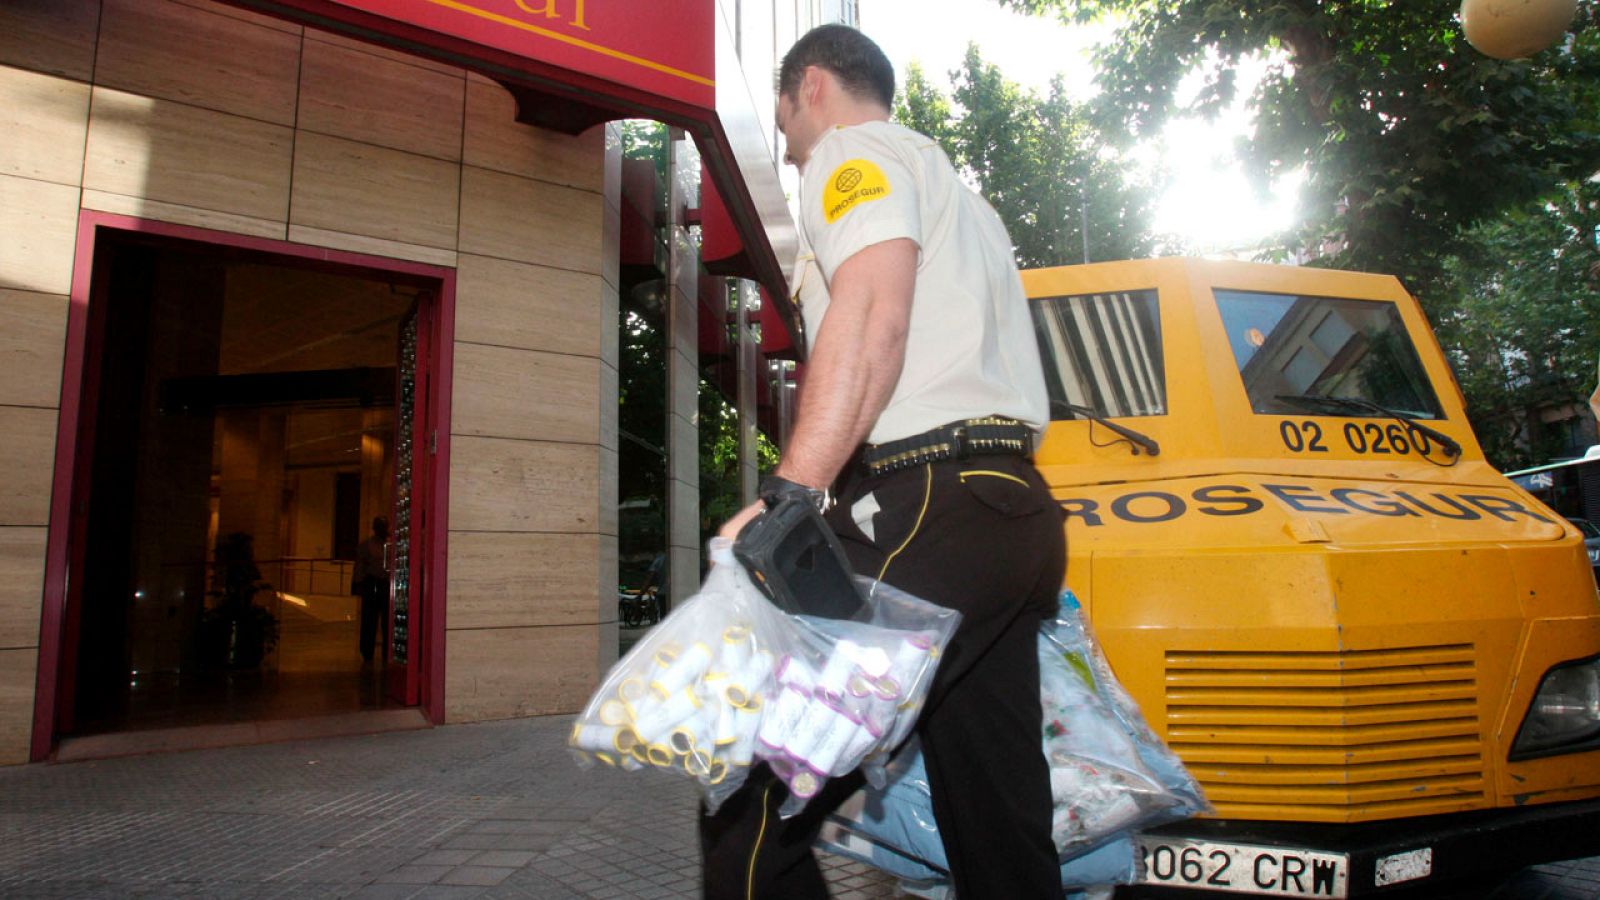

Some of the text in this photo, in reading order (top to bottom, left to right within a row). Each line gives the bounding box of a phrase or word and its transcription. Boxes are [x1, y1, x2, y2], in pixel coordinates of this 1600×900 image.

[830, 186, 885, 218] PROSEGUR
[1279, 420, 1431, 456] 02 0260
[1140, 845, 1336, 896] 062 CRW
